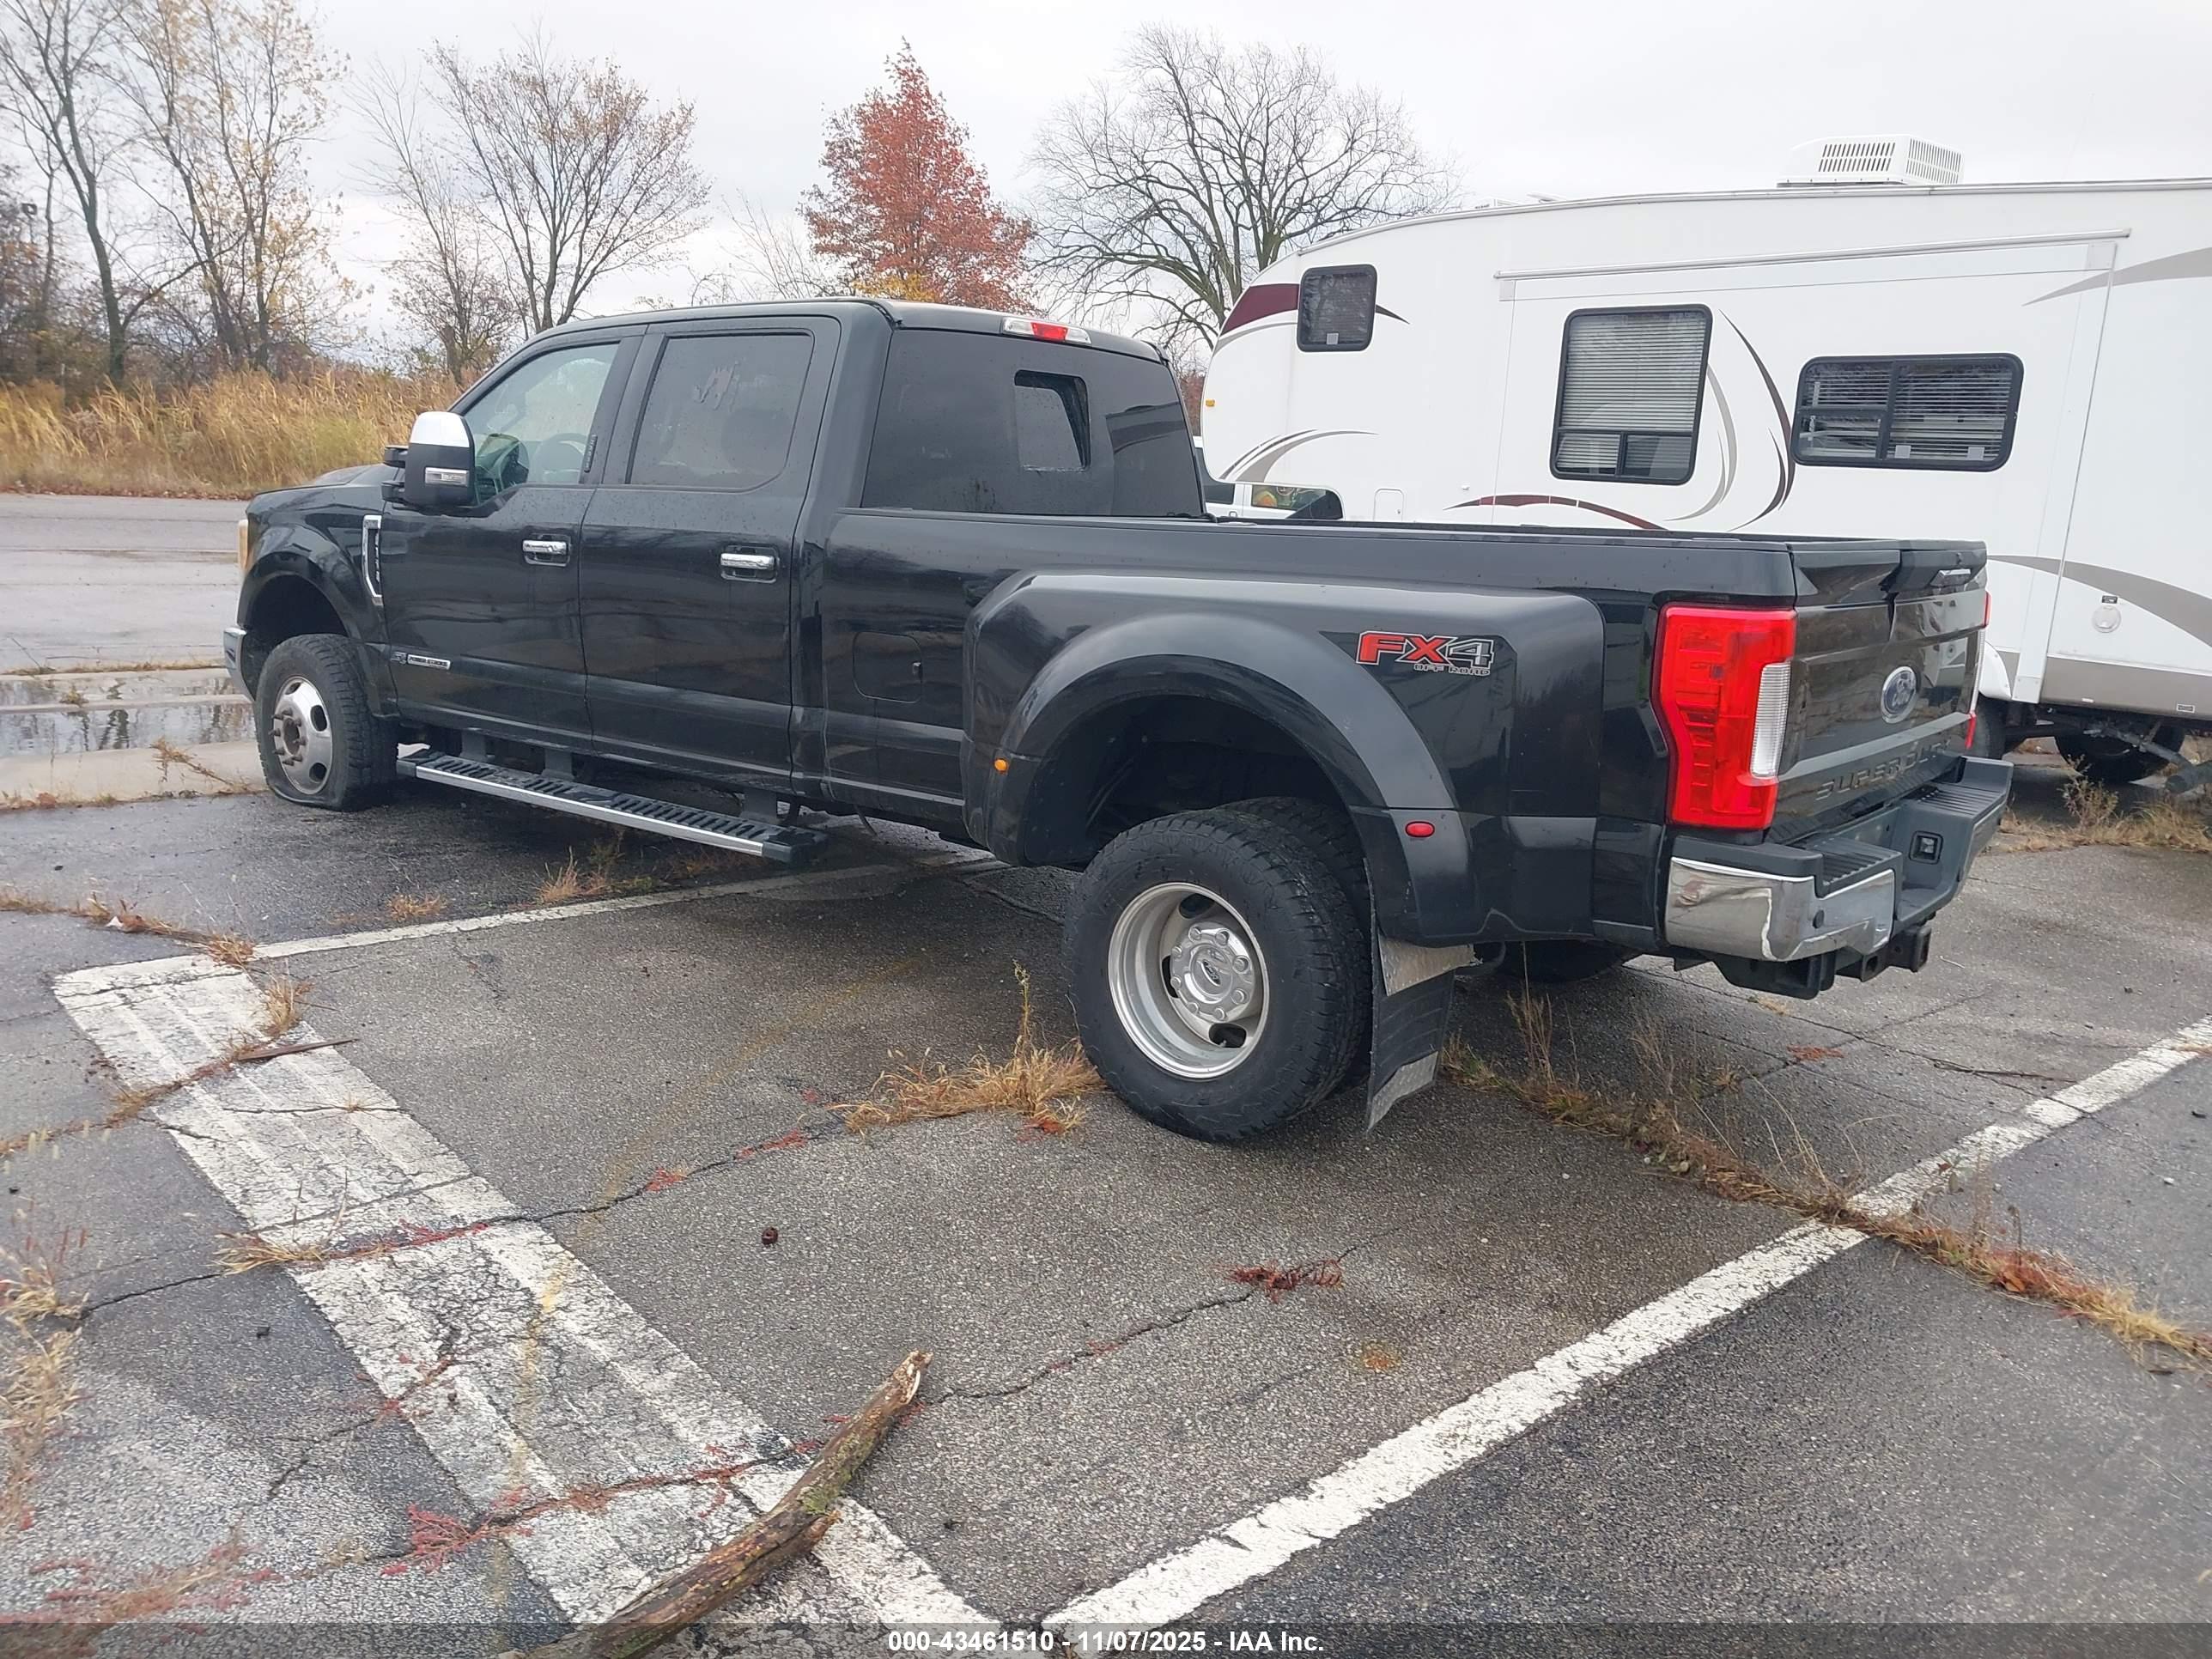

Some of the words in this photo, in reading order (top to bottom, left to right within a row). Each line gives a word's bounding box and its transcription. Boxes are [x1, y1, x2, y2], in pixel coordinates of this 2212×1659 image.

[1356, 630, 1495, 669] FX4
[1413, 663, 1445, 672] OFF
[1448, 665, 1491, 677] ROAD
